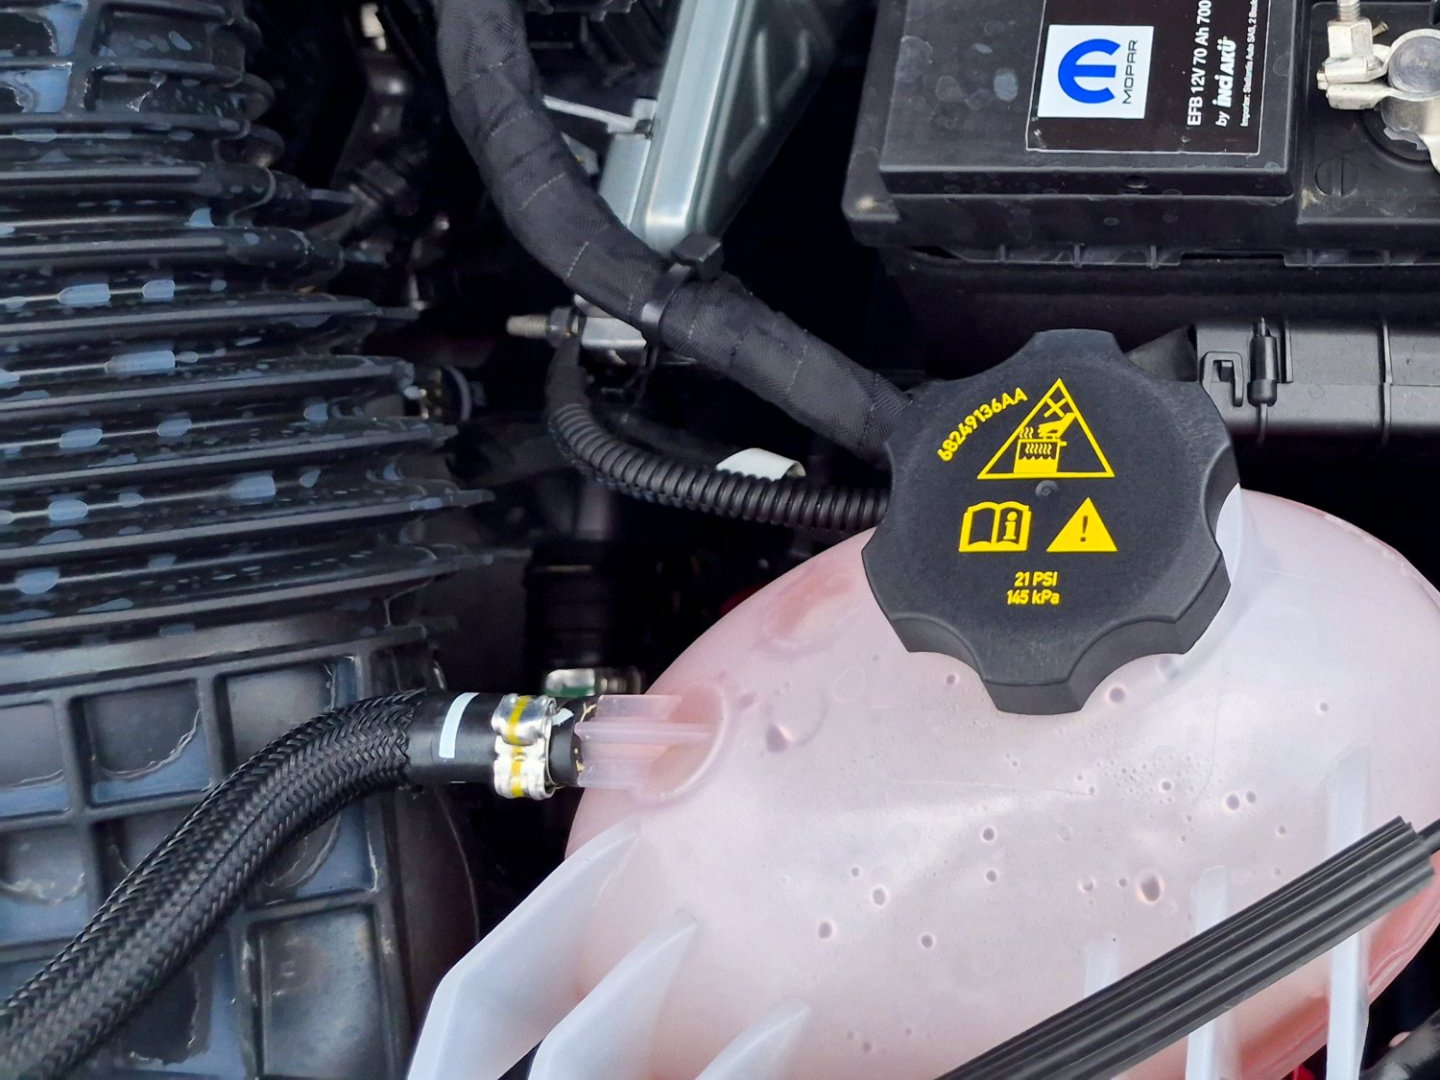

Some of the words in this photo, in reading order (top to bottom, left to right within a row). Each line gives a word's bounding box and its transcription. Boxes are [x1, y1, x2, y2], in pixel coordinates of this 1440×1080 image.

[1197, 0, 1212, 24] 700
[1194, 27, 1210, 46] Ah
[1192, 48, 1207, 66] 70
[1122, 40, 1138, 104] MOPAR
[1190, 67, 1206, 94] 12V
[1187, 96, 1203, 125] EFB
[1215, 111, 1230, 127] by
[937, 387, 1028, 461] 68249136AA
[1014, 571, 1030, 587] 21
[1033, 571, 1058, 587] PSI
[1007, 589, 1030, 605] 145
[1031, 589, 1060, 605] kPa
